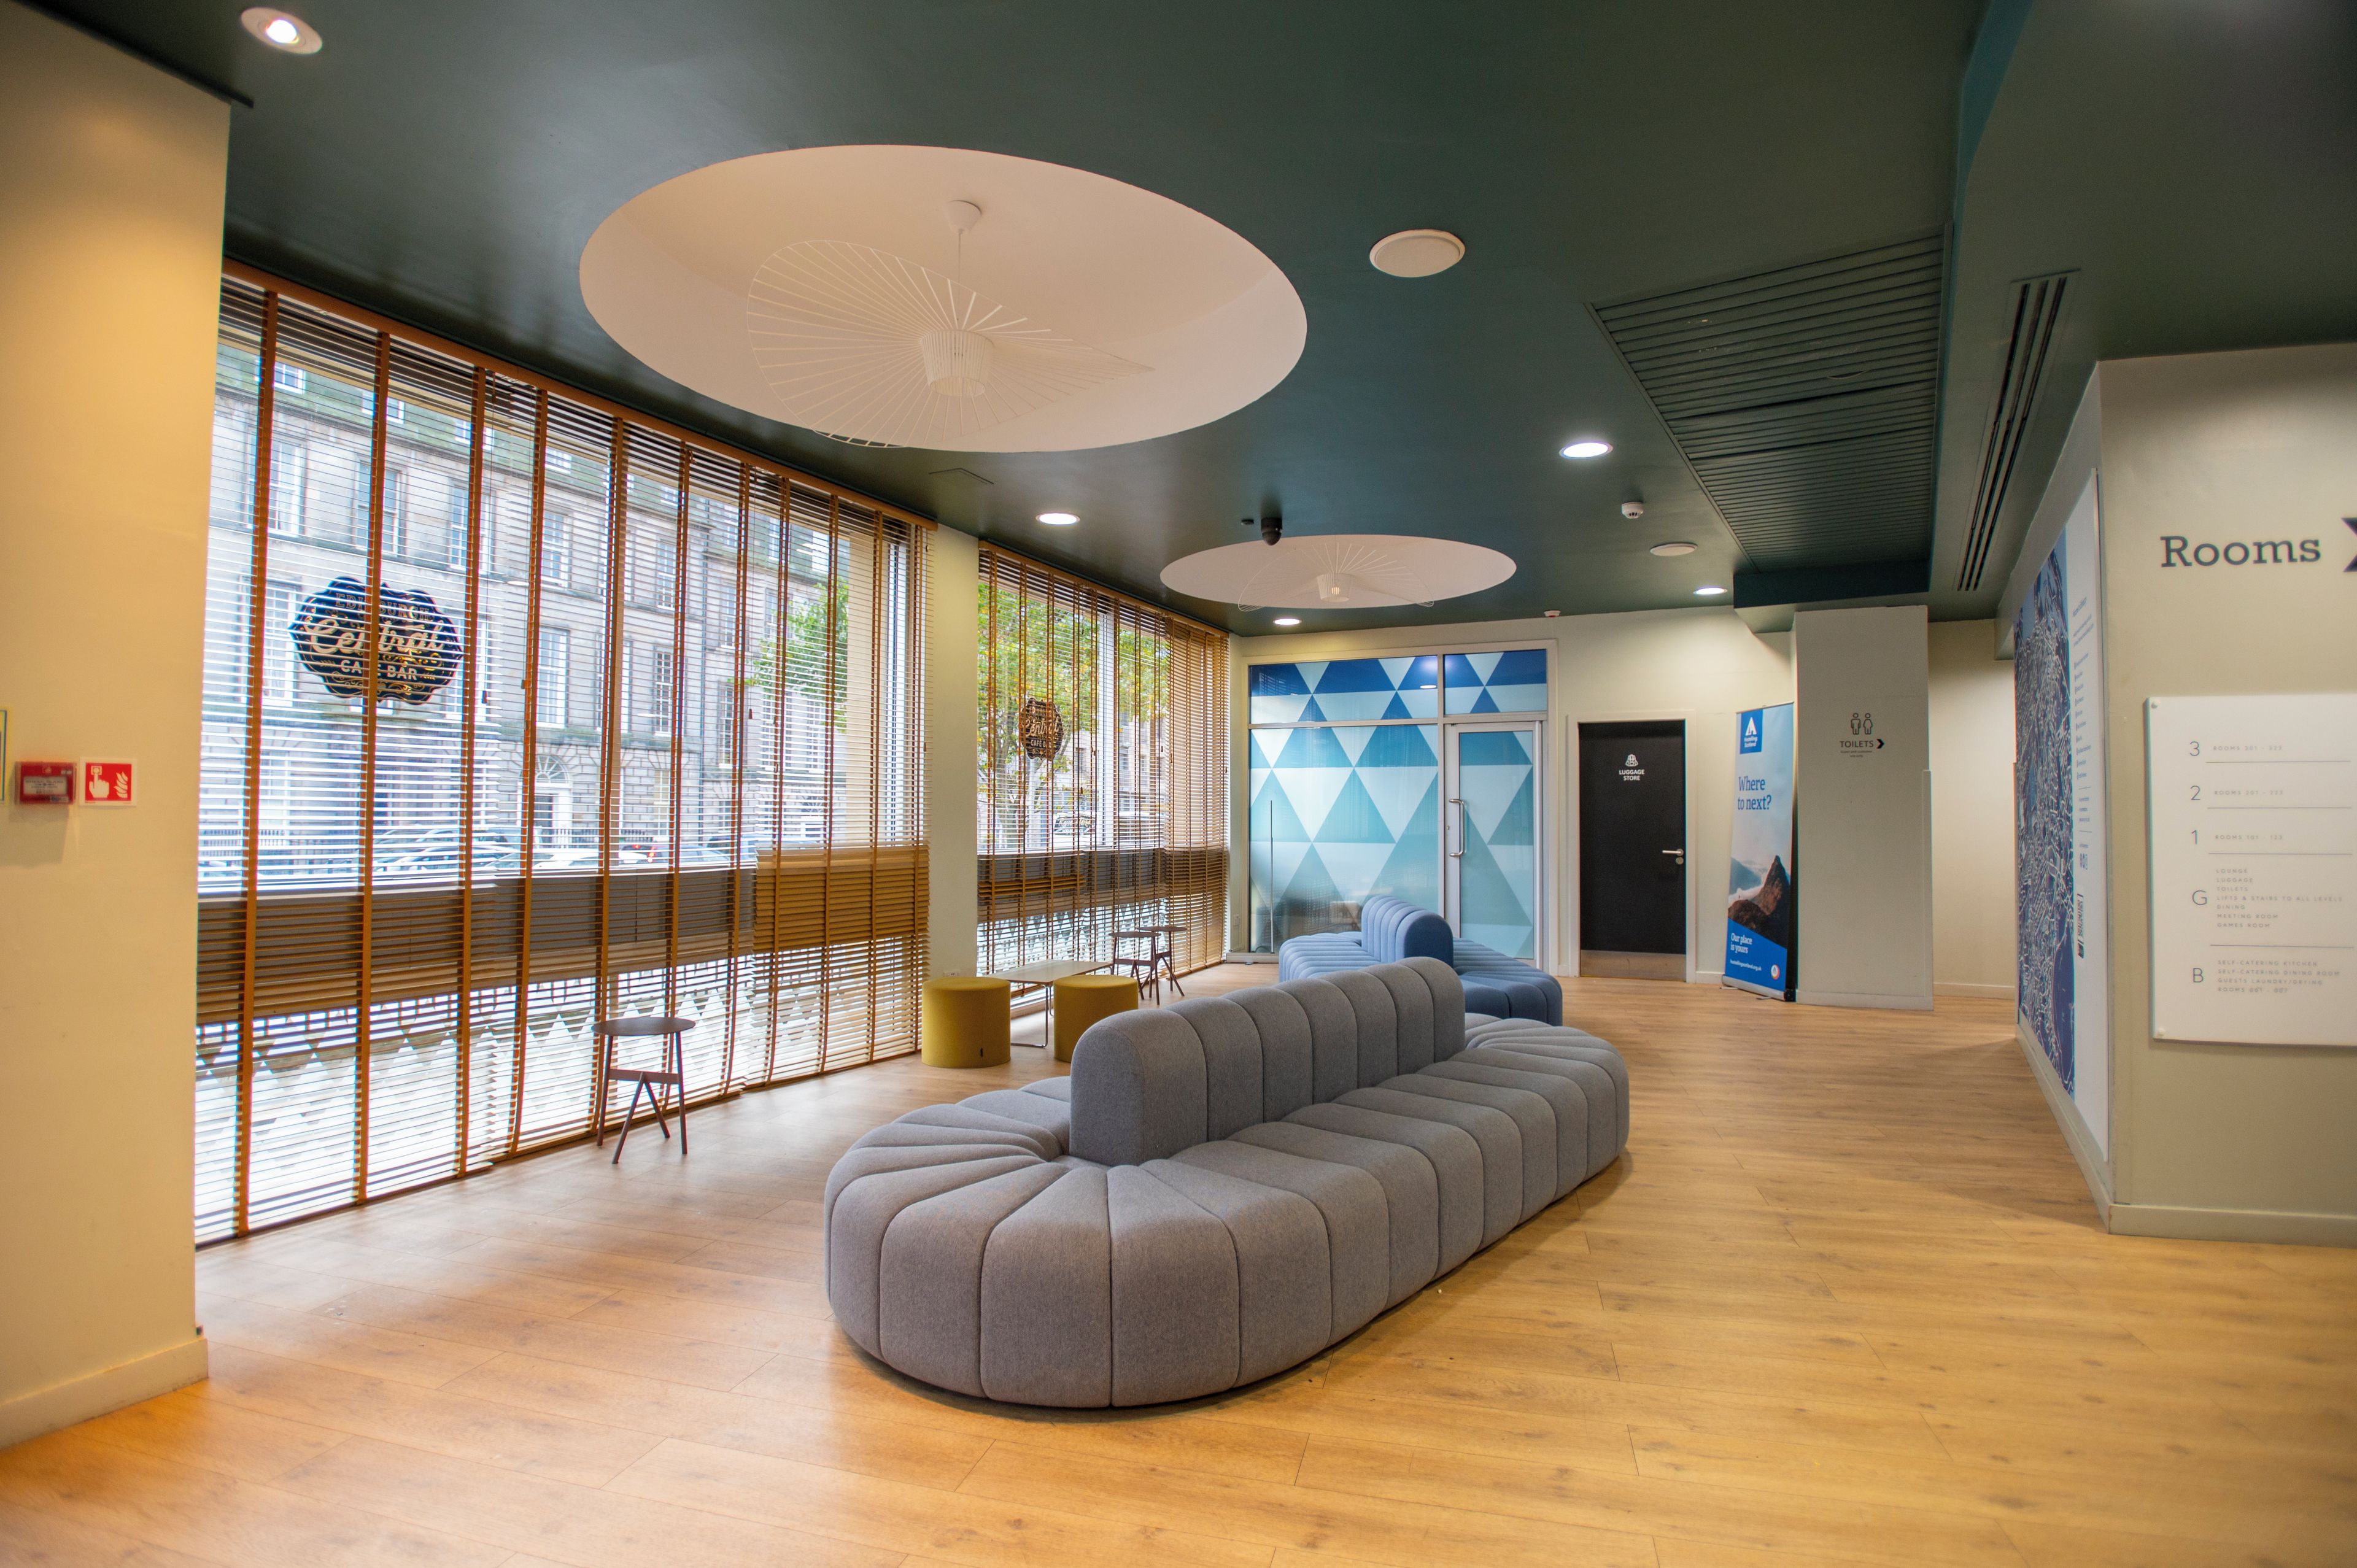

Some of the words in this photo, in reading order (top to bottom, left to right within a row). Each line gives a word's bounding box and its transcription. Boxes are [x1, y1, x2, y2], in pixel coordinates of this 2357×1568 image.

[2160, 536, 2321, 568] Rooms
[335, 592, 432, 621] EDIBURGH
[387, 664, 417, 681] BAR
[2189, 741, 2200, 757] 3
[1738, 776, 1765, 791] Where
[2190, 785, 2201, 801] 2
[1738, 797, 1744, 810] to
[1746, 794, 1771, 810] next?
[2191, 830, 2198, 845] 1
[2192, 890, 2208, 906] G
[1730, 941, 1735, 951] is
[1731, 933, 1740, 942] Our
[1740, 935, 1752, 945] place
[2193, 968, 2204, 983] B
